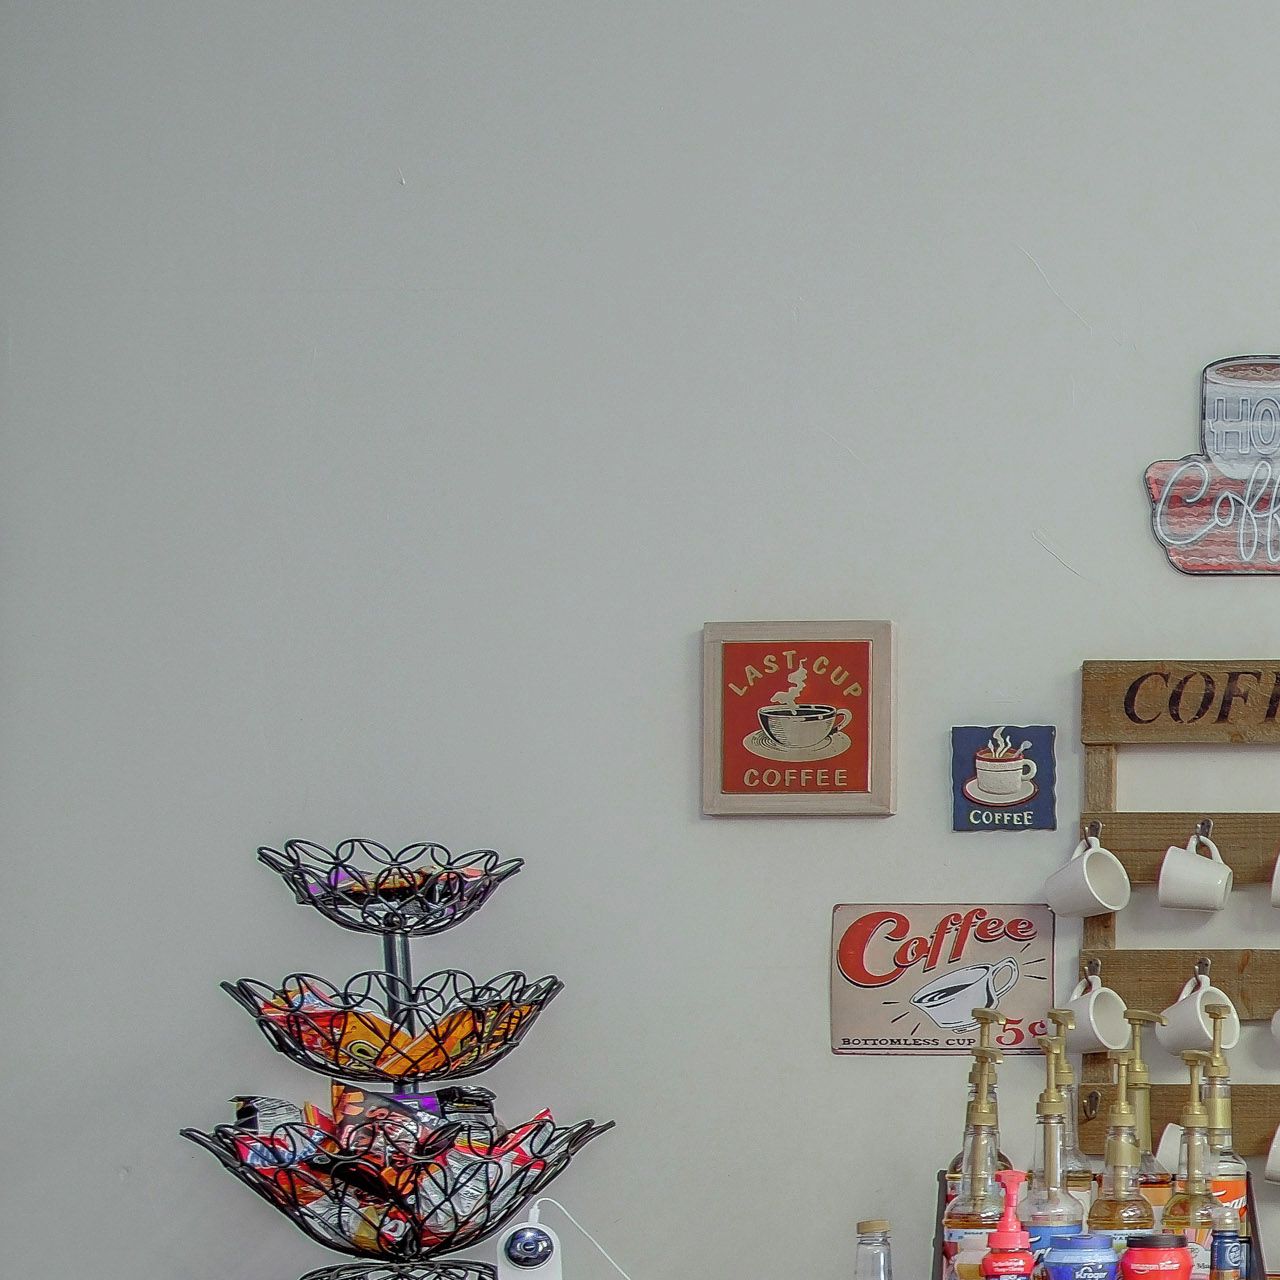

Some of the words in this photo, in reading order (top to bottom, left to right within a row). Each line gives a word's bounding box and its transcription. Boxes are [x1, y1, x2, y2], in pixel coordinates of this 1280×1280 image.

[726, 650, 798, 697] LAST
[812, 657, 862, 698] CUP
[743, 768, 849, 787] COFFEE
[969, 808, 1033, 826] COFFEE
[837, 907, 1038, 989] Coffee
[841, 1037, 939, 1047] BOTTOMLESS
[945, 1037, 977, 1047] CUP
